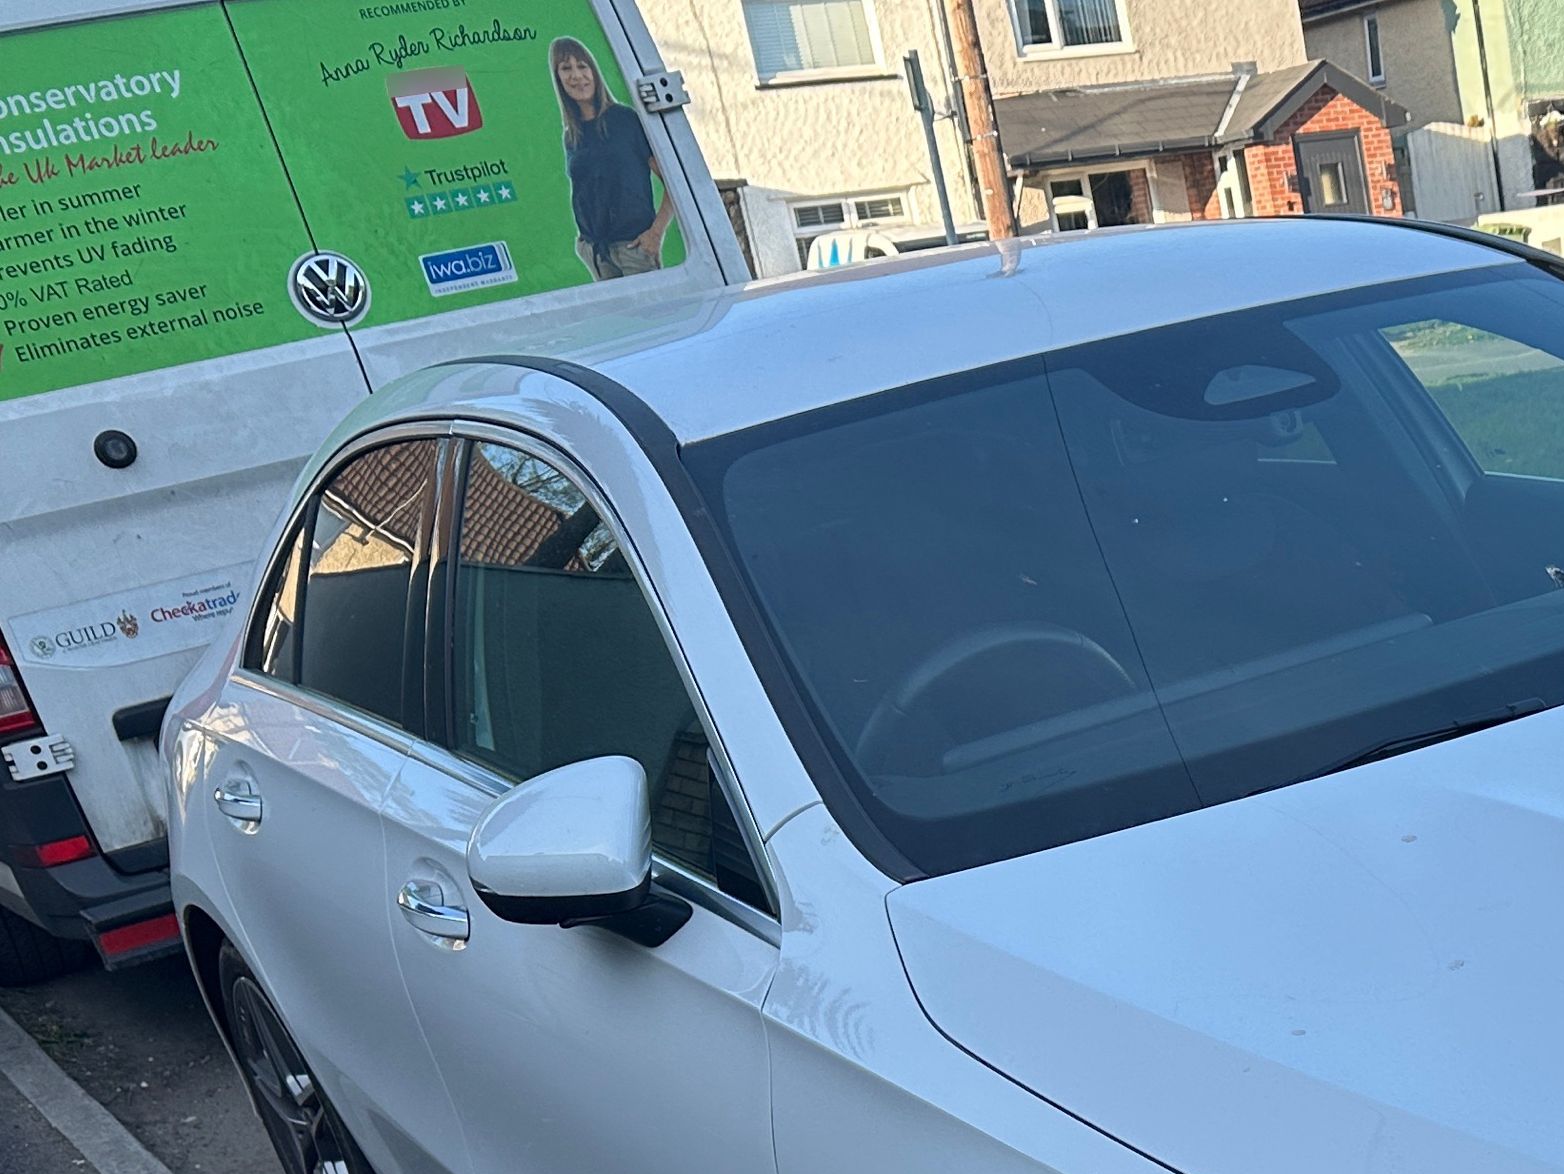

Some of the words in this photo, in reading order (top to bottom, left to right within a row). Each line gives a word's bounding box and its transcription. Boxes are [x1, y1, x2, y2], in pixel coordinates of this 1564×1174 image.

[359, 0, 450, 20] RECOMMENDED
[319, 61, 370, 87] Anna
[368, 35, 430, 69] Ryder
[429, 18, 537, 51] Richardson
[395, 87, 468, 134] TV
[65, 143, 147, 177] Market
[151, 131, 220, 160] leader
[424, 158, 509, 186] Trustpilot
[31, 199, 54, 216] in
[58, 183, 142, 211] summer
[59, 222, 81, 240] in
[84, 216, 119, 235] the
[122, 204, 188, 227] winter
[77, 244, 105, 264] UV
[111, 234, 178, 258] fading
[427, 251, 497, 280] iwa.biz
[30, 280, 70, 303] VAT
[75, 269, 134, 296] Rated
[4, 310, 78, 337] Proven
[82, 295, 150, 321] energy
[155, 283, 209, 307] saver
[15, 329, 123, 363] Eliminates
[126, 309, 209, 340] external
[212, 301, 265, 324] noise
[150, 589, 241, 624] Checkatrad
[55, 621, 117, 649] GUILD
